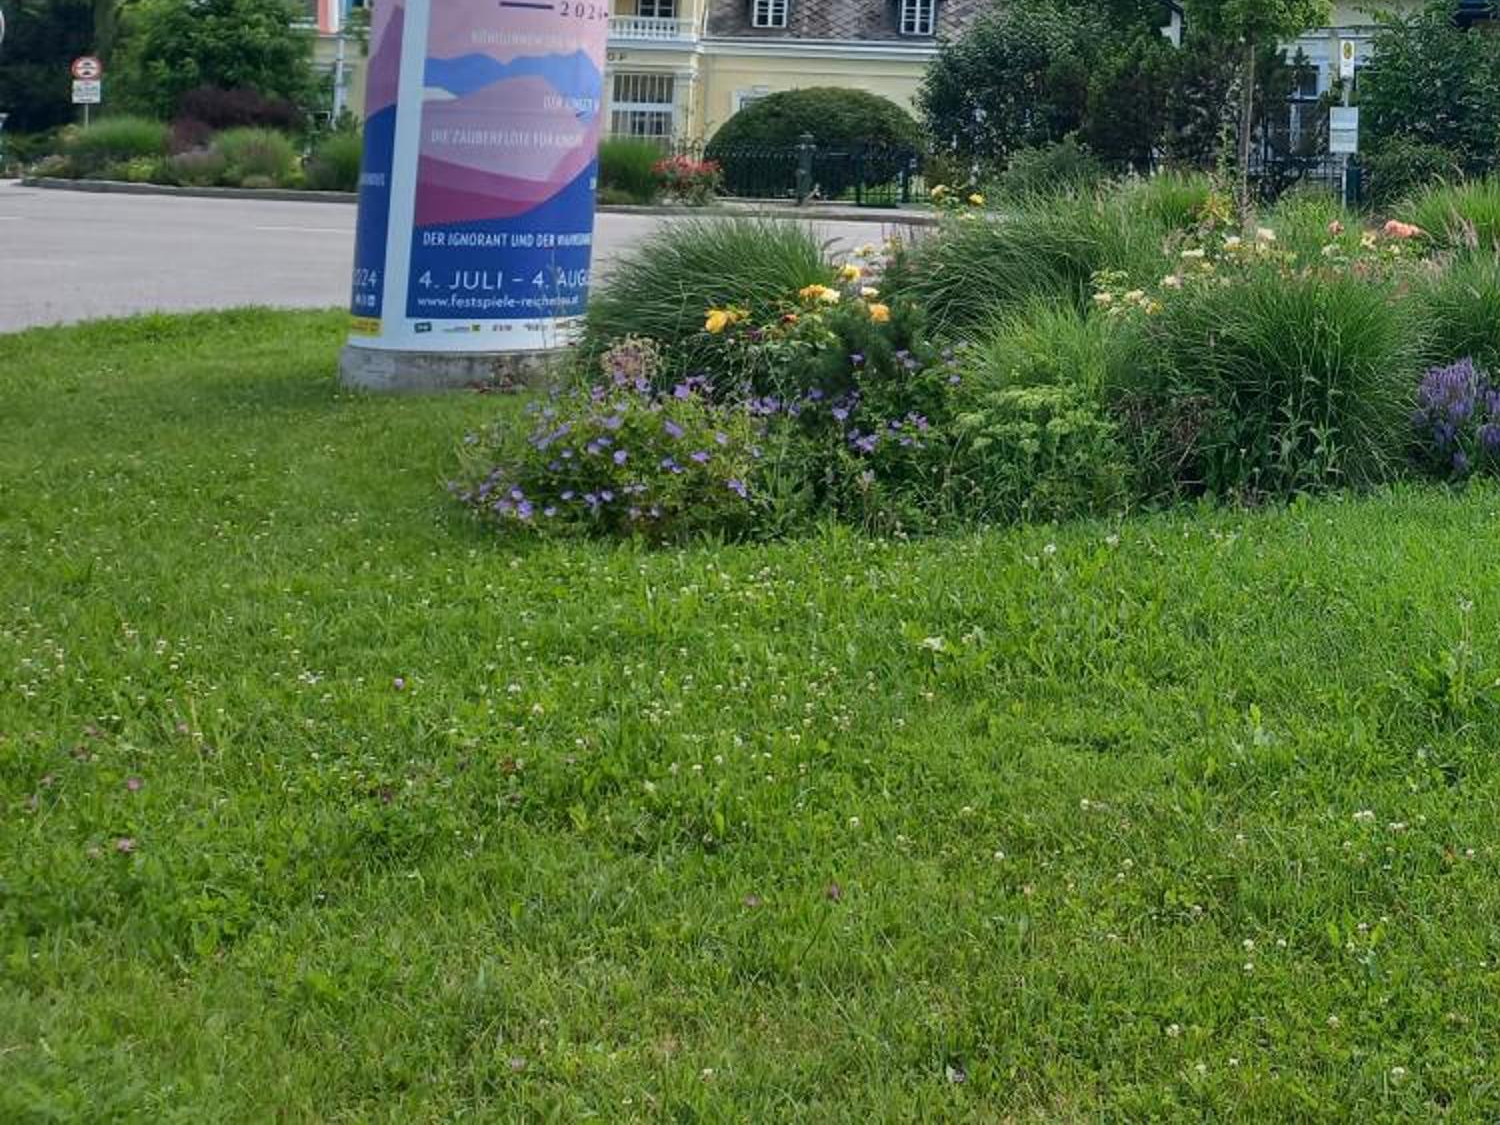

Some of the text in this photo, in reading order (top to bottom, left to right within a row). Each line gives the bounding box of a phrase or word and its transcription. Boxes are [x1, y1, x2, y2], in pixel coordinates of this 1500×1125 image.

[423, 232, 445, 247] DER
[448, 232, 507, 247] IGNORANT
[511, 233, 534, 248] UND
[536, 233, 555, 248] DER
[418, 270, 440, 289] 4.
[449, 270, 503, 290] JULI
[532, 270, 550, 289] 4.
[557, 268, 589, 289] AUG
